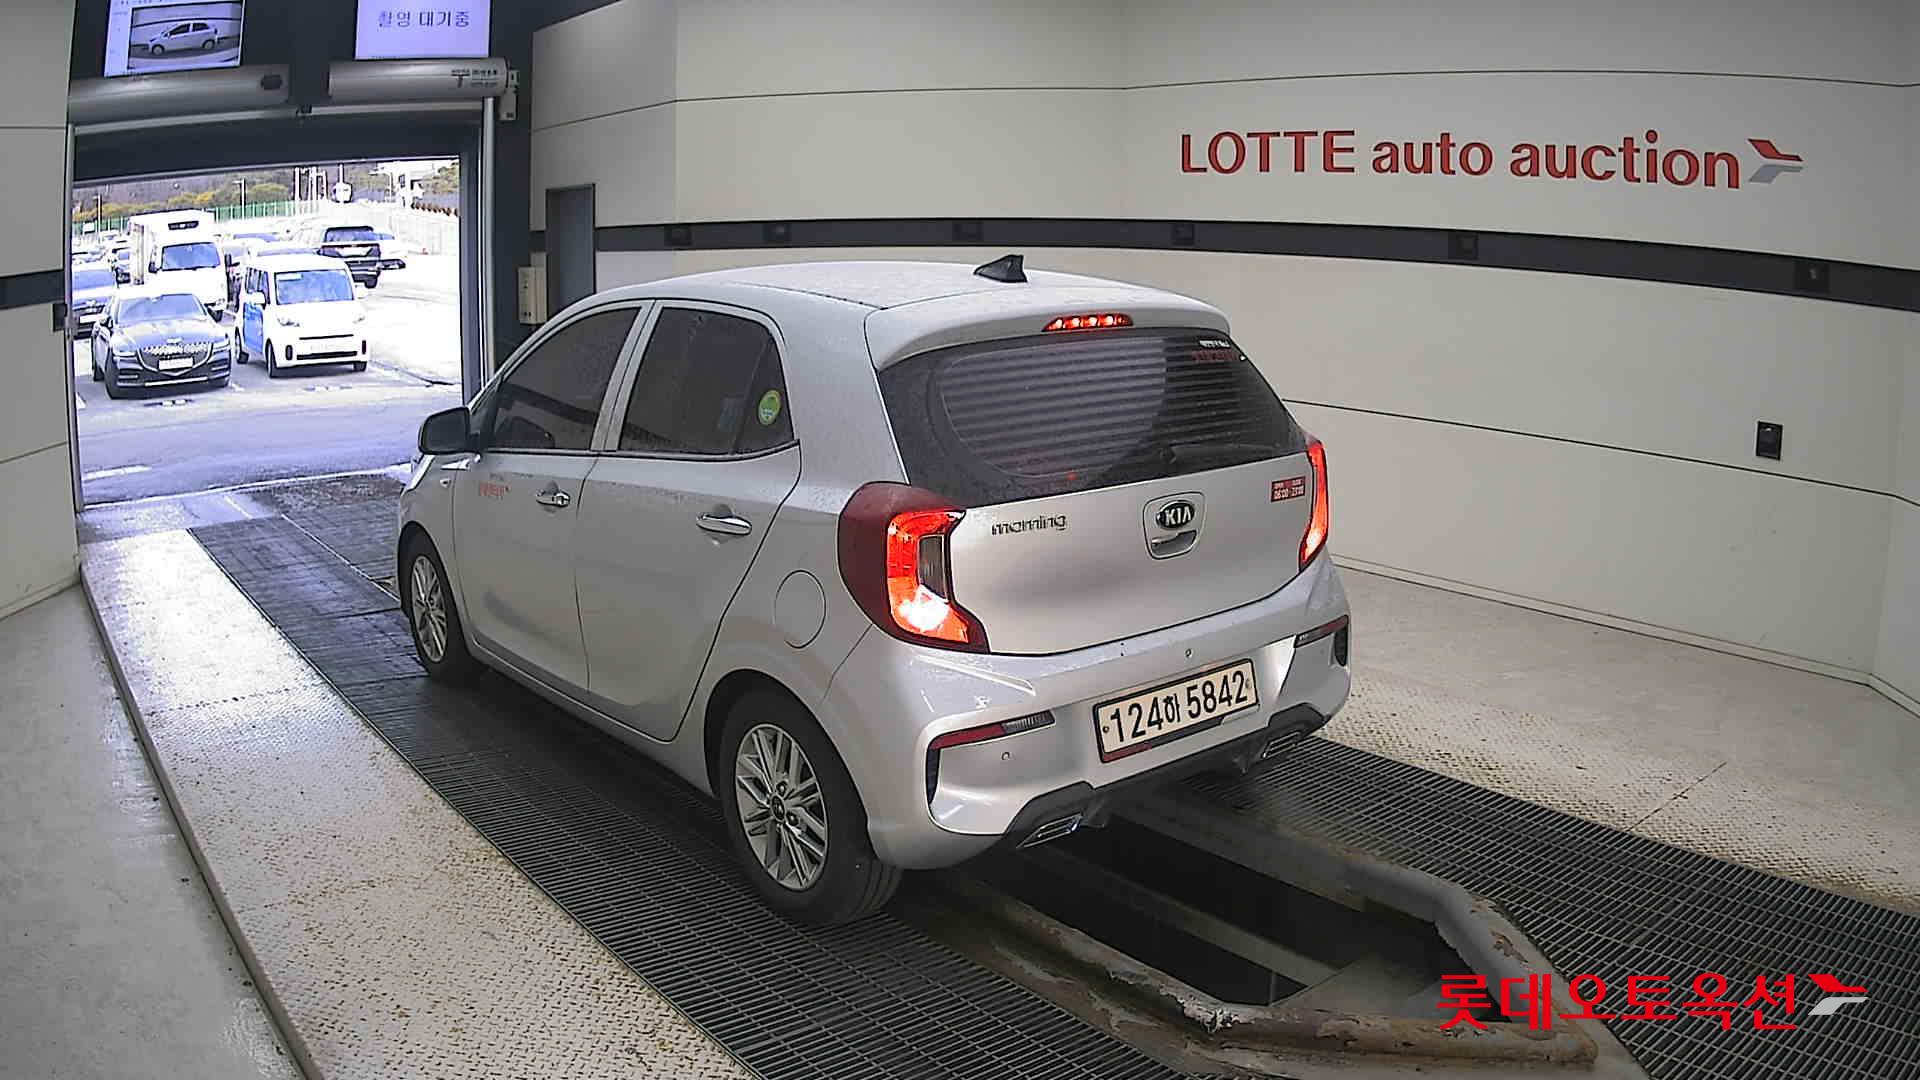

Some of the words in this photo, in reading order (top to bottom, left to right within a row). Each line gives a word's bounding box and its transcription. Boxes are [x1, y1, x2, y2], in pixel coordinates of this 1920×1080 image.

[418, 10, 470, 28] 대기중
[1181, 131, 1355, 174] LOTTE
[1373, 133, 1493, 176] auto
[1510, 130, 1741, 189] auction
[991, 514, 1067, 536] morning
[1164, 506, 1191, 526] KIA
[1110, 692, 1181, 743] 124하
[1186, 670, 1249, 720] 5842
